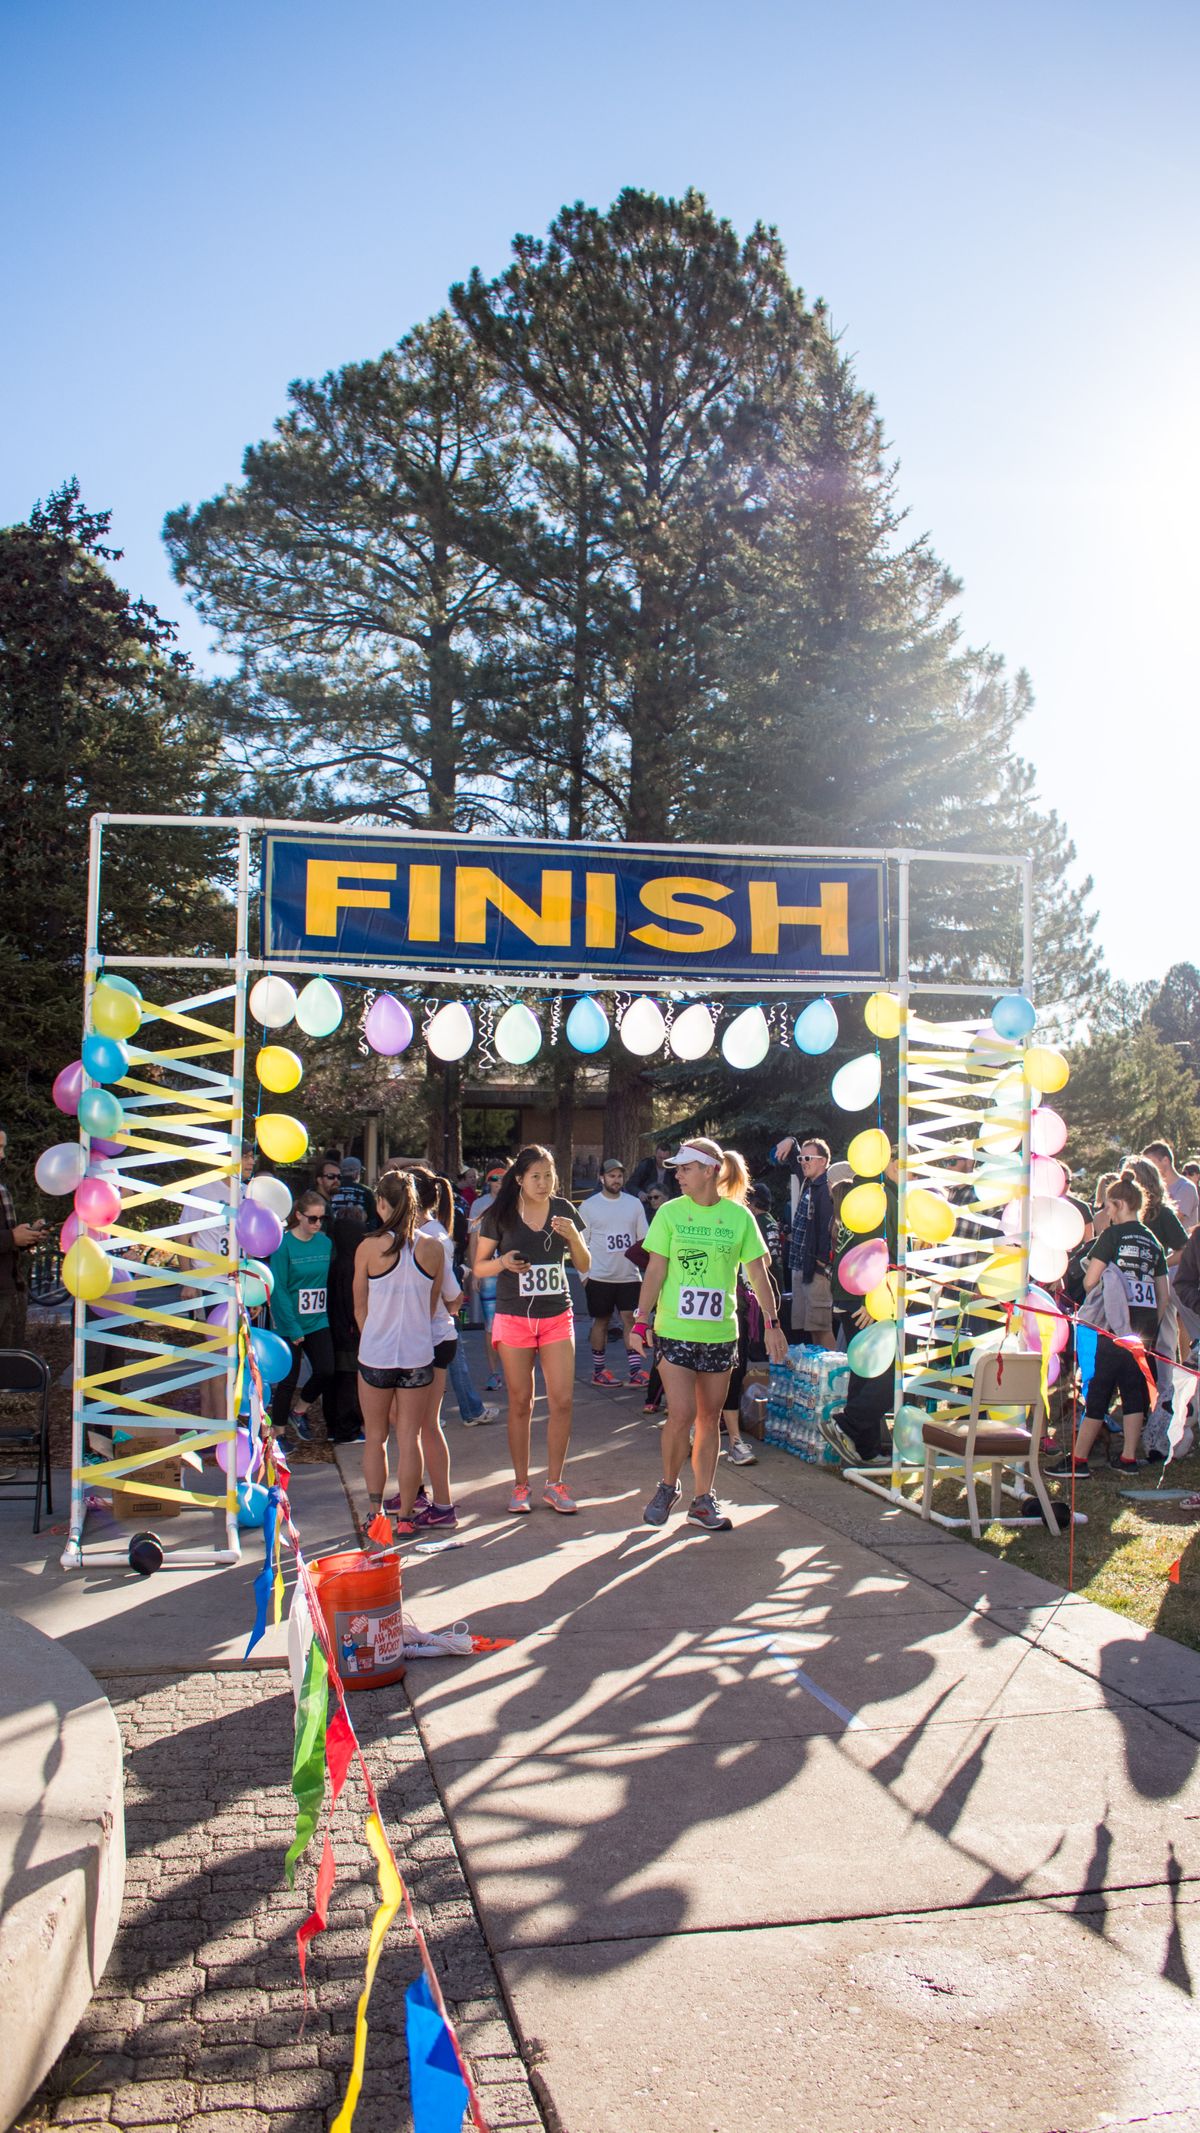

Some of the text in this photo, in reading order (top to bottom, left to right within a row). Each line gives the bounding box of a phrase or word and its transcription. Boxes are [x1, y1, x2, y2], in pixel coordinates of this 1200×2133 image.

[305, 859, 849, 956] FINISH
[607, 1233, 632, 1250] 363
[522, 1267, 560, 1292] 386
[301, 1290, 326, 1311] 379
[681, 1290, 723, 1317] 378
